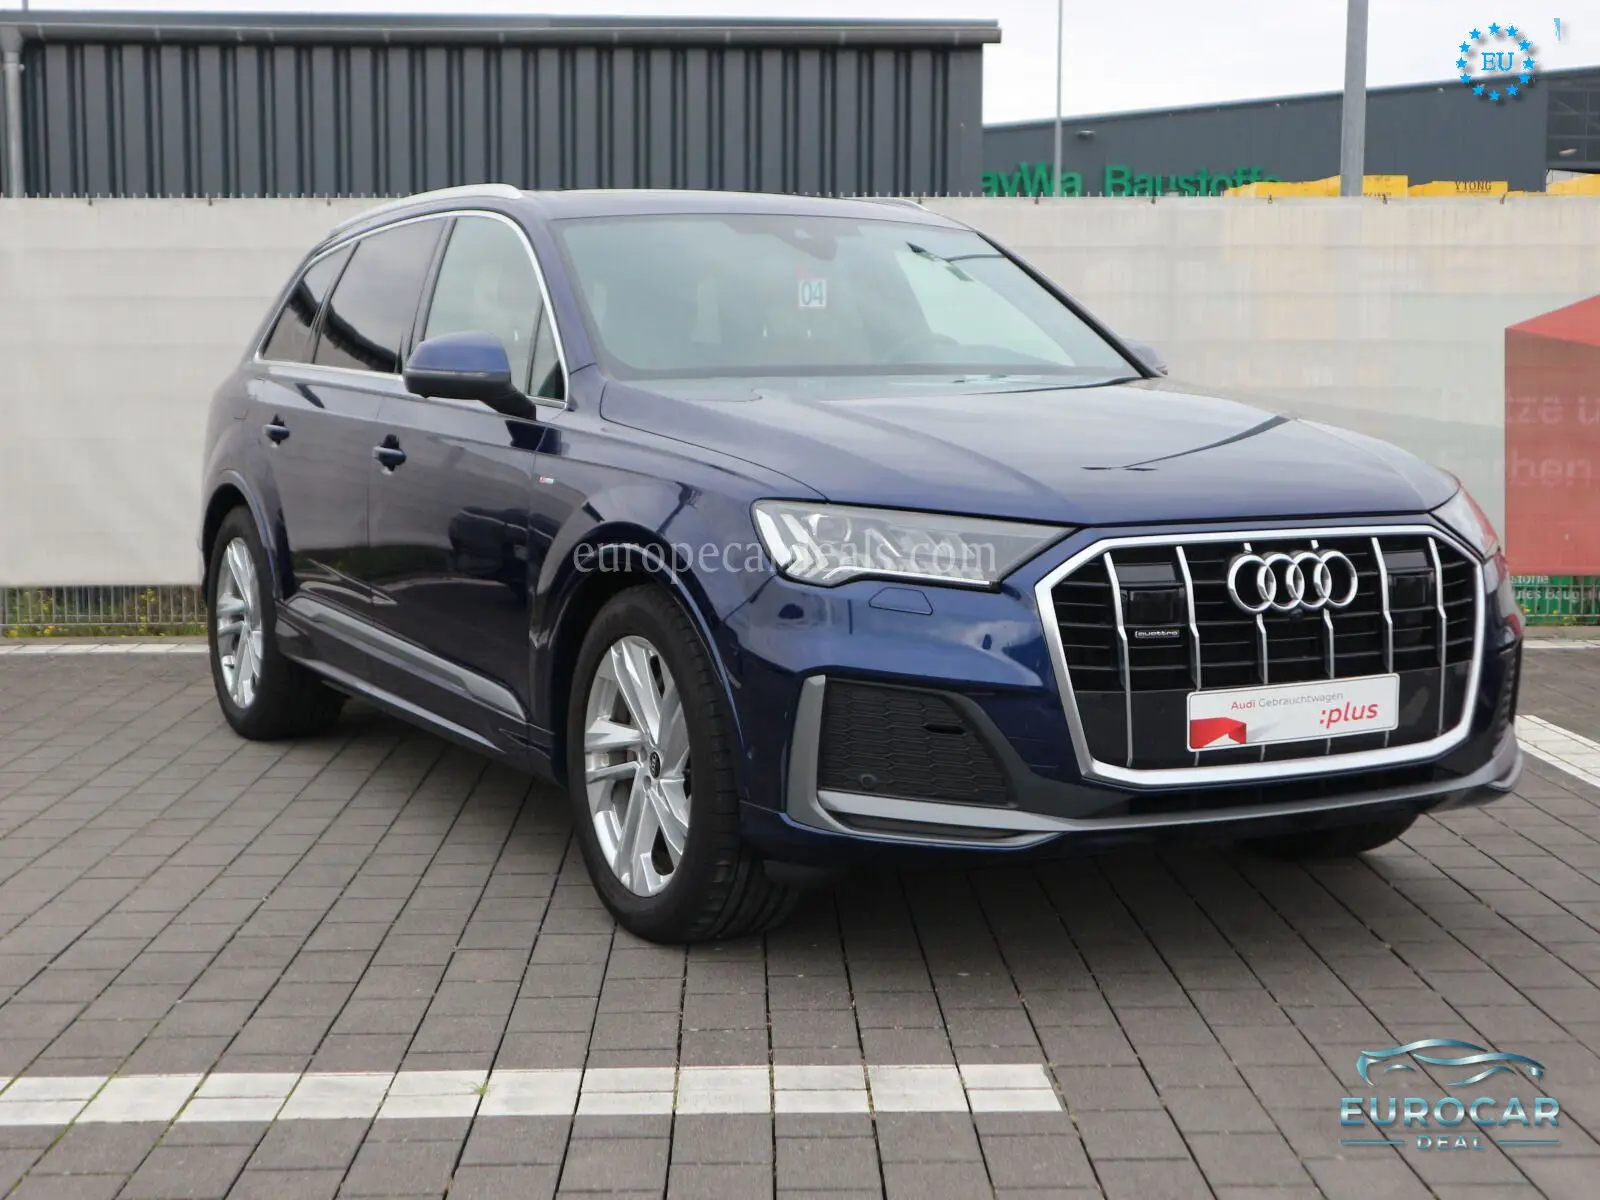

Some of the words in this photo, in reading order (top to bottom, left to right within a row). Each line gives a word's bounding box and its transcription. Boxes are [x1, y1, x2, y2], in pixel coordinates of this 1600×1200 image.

[1455, 181, 1492, 191] YTONG
[801, 281, 823, 305] 04
[1135, 630, 1179, 638] quattro
[1231, 700, 1256, 710] Audi
[1259, 692, 1343, 708] Gebrauchtwagen
[1319, 702, 1378, 729] :plus
